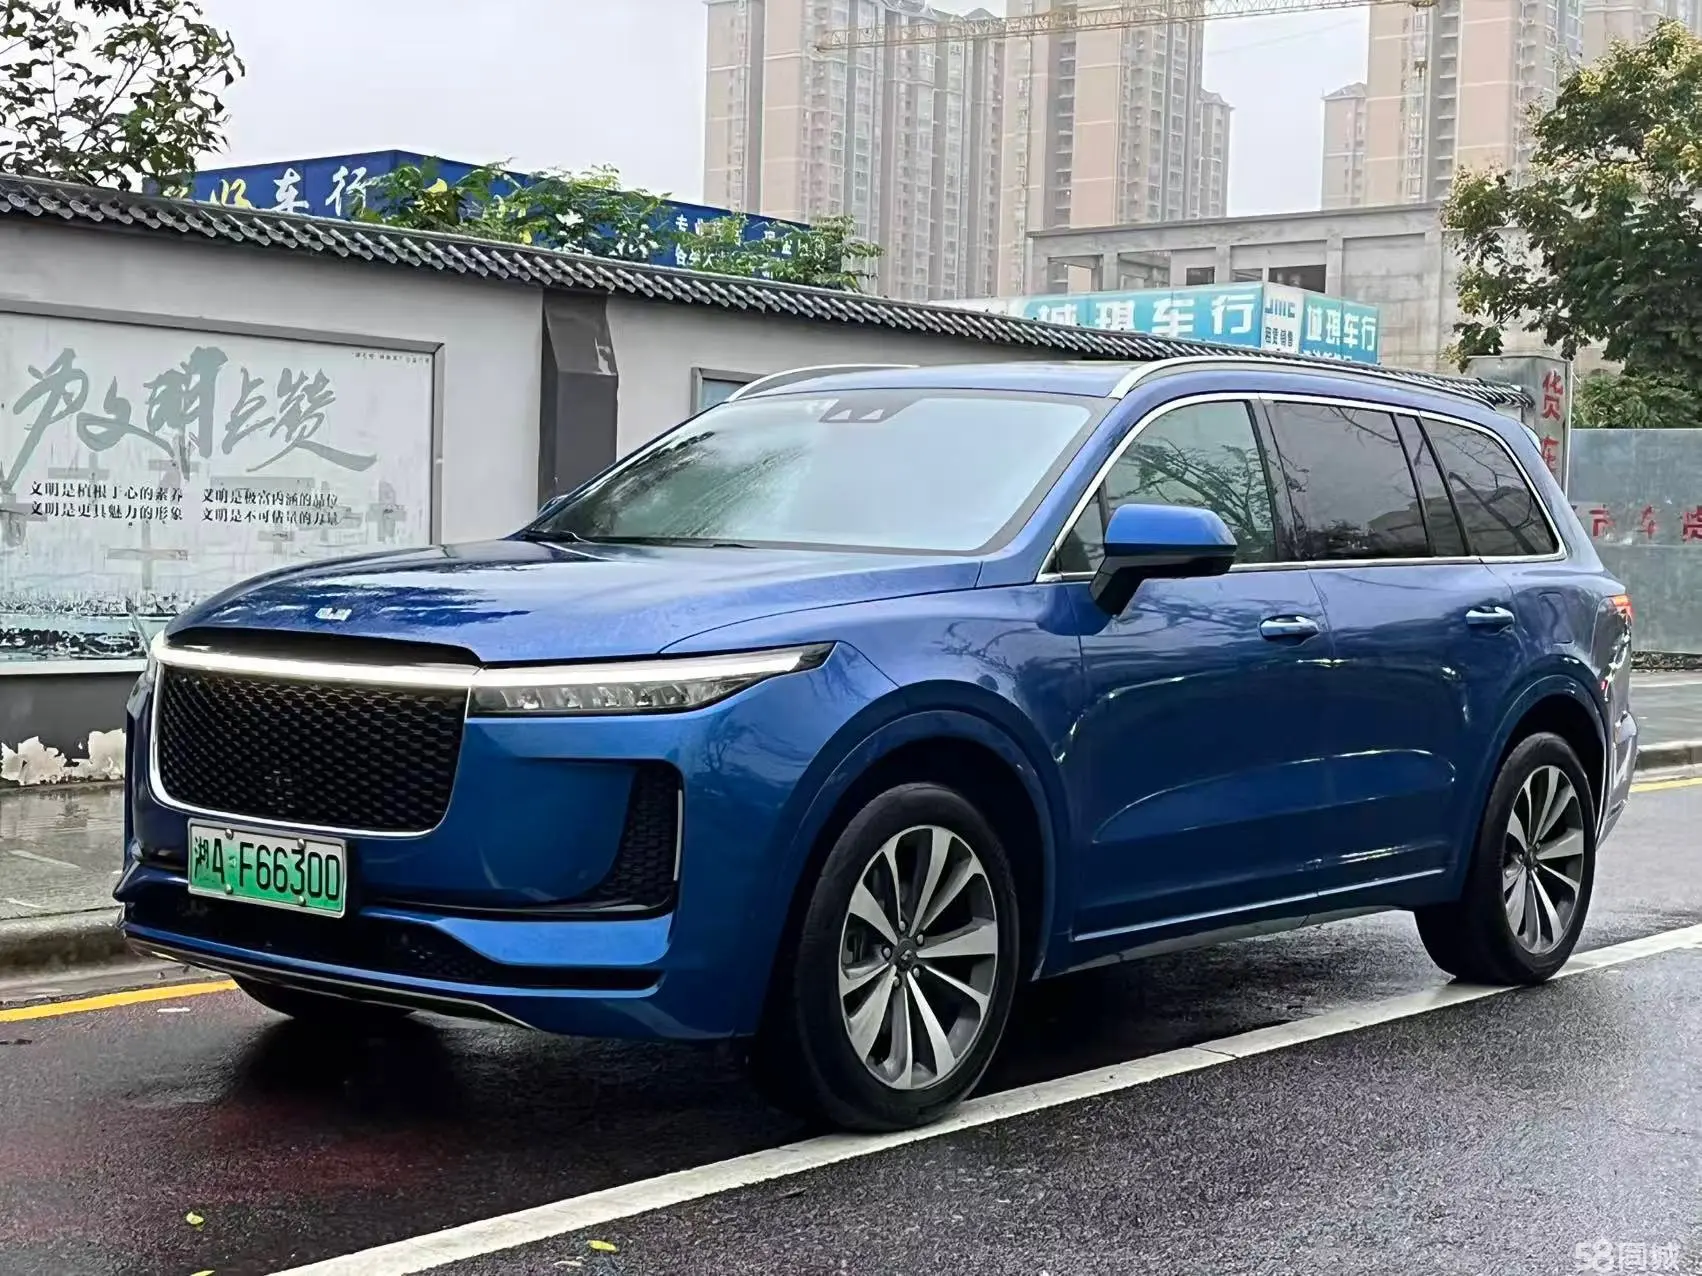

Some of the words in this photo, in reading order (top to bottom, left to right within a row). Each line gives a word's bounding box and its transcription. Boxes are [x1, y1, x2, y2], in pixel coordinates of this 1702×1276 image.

[29, 480, 184, 503] 文明是植根于心的素养
[30, 500, 184, 521] 文明是更具魅力的形象
